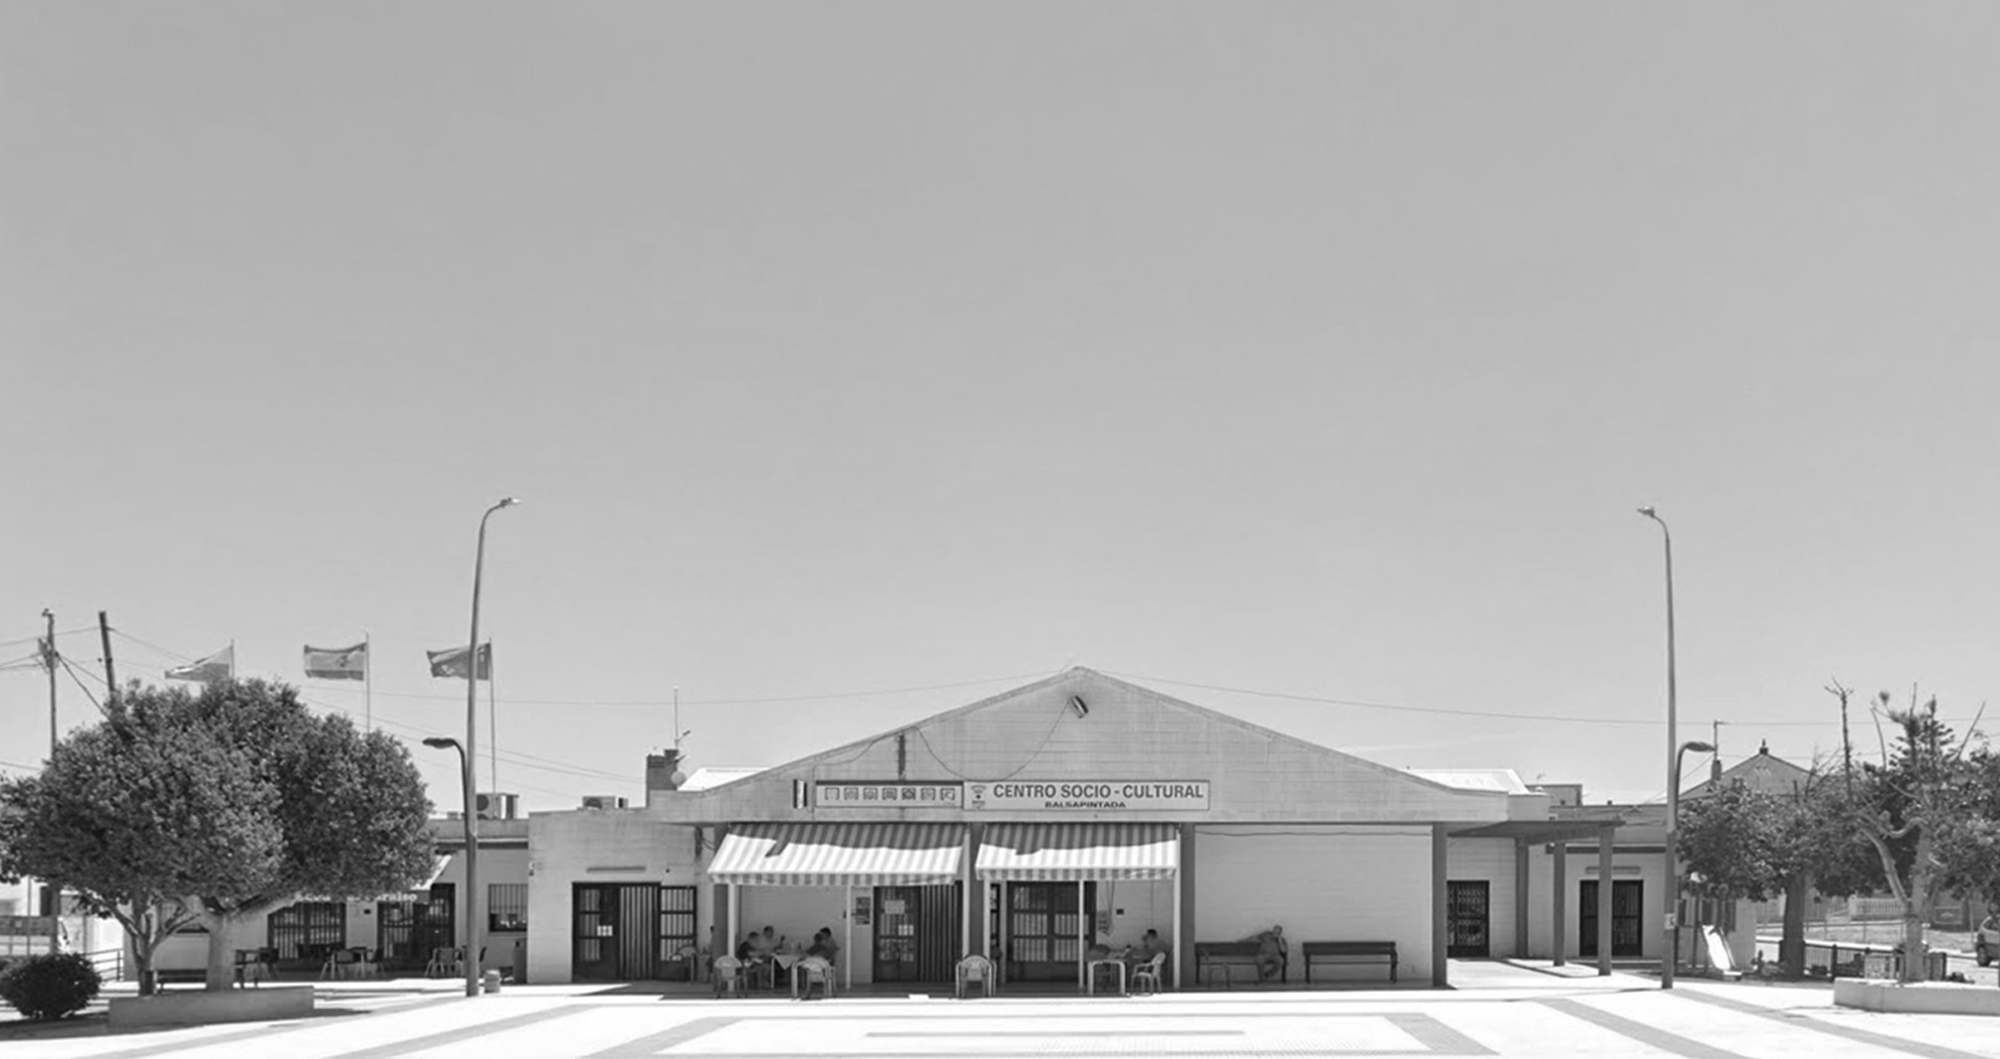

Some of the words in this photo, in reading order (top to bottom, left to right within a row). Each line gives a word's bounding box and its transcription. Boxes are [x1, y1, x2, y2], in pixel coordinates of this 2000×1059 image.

[993, 784, 1057, 799] CENTRO
[1060, 784, 1112, 799] SOCIO
[1122, 784, 1205, 799] CULTURAL
[1044, 801, 1127, 809] BALSAPINTADA
